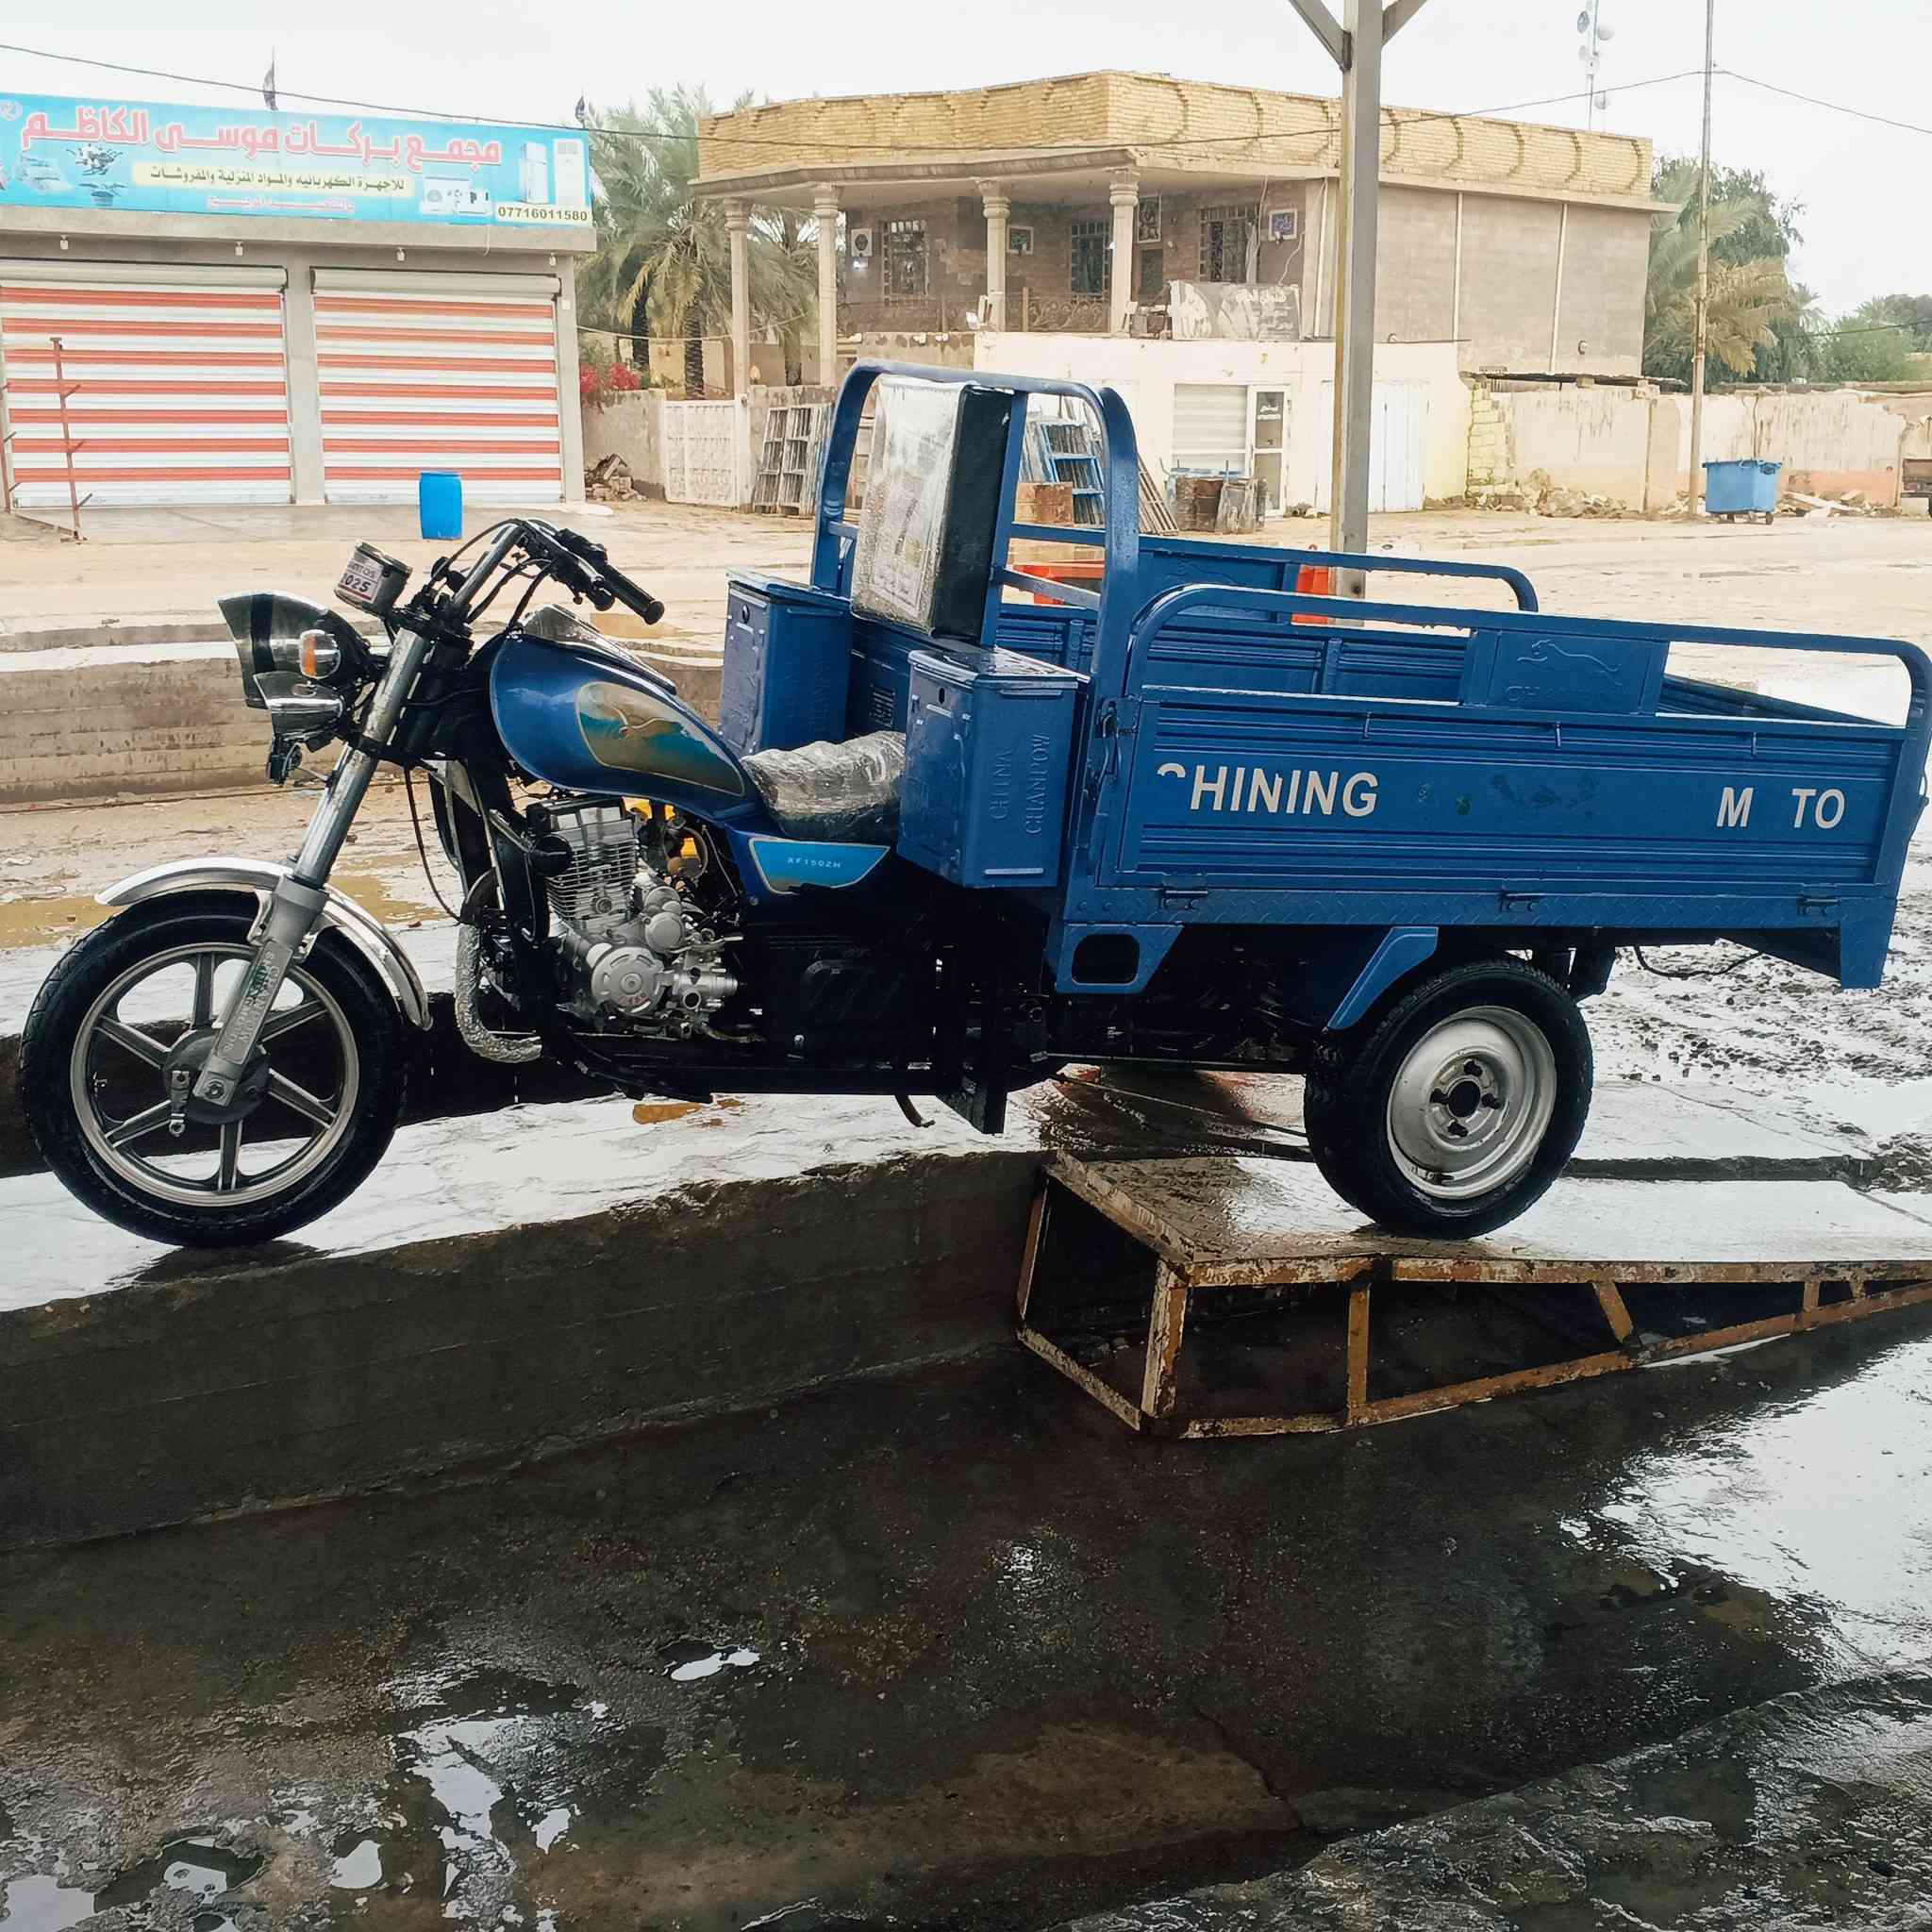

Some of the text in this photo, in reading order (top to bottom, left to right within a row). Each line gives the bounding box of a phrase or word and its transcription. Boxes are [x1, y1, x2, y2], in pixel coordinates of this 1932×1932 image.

[22, 105, 149, 152] الكاظم
[154, 123, 280, 160] موسى
[284, 120, 401, 167] بركات
[406, 135, 502, 173] مجمع
[498, 207, 588, 221] 07716011580
[989, 750, 1013, 821] CHINA
[1157, 762, 1379, 818] HINING
